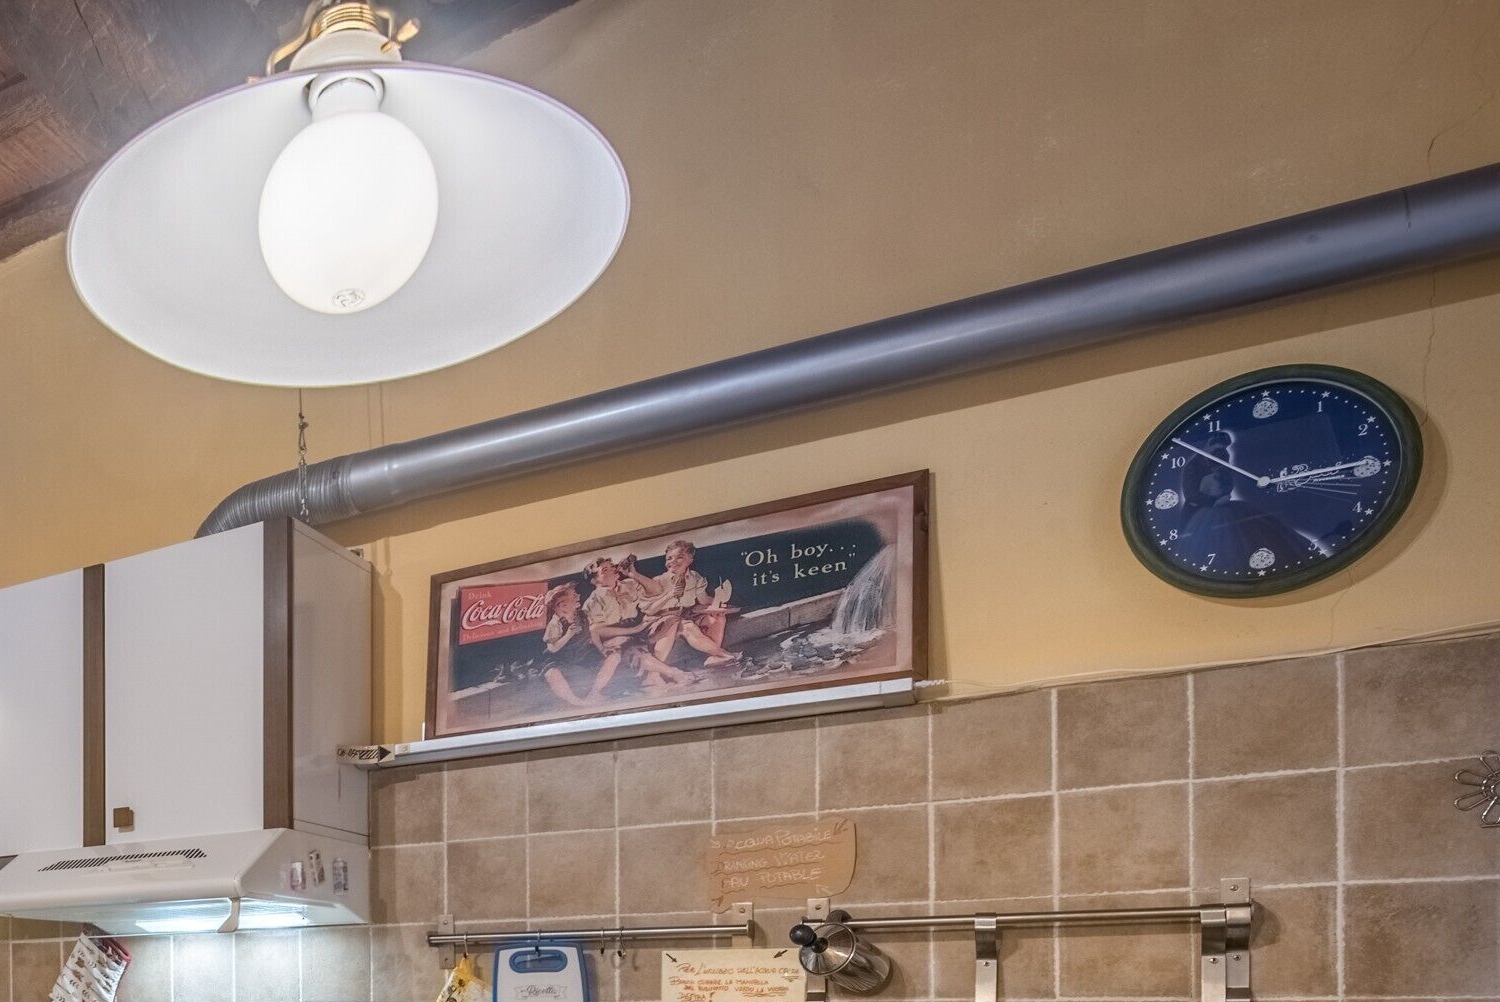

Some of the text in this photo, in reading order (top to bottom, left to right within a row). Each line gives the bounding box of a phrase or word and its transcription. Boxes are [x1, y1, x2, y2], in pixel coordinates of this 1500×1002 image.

[1315, 400, 1323, 413] 1
[1208, 420, 1221, 433] 11
[1357, 423, 1369, 437] 2
[1171, 456, 1186, 469] 10
[1351, 501, 1363, 514] 4
[1168, 529, 1178, 541] 8
[1207, 553, 1216, 565] 7
[752, 570, 780, 586] it's
